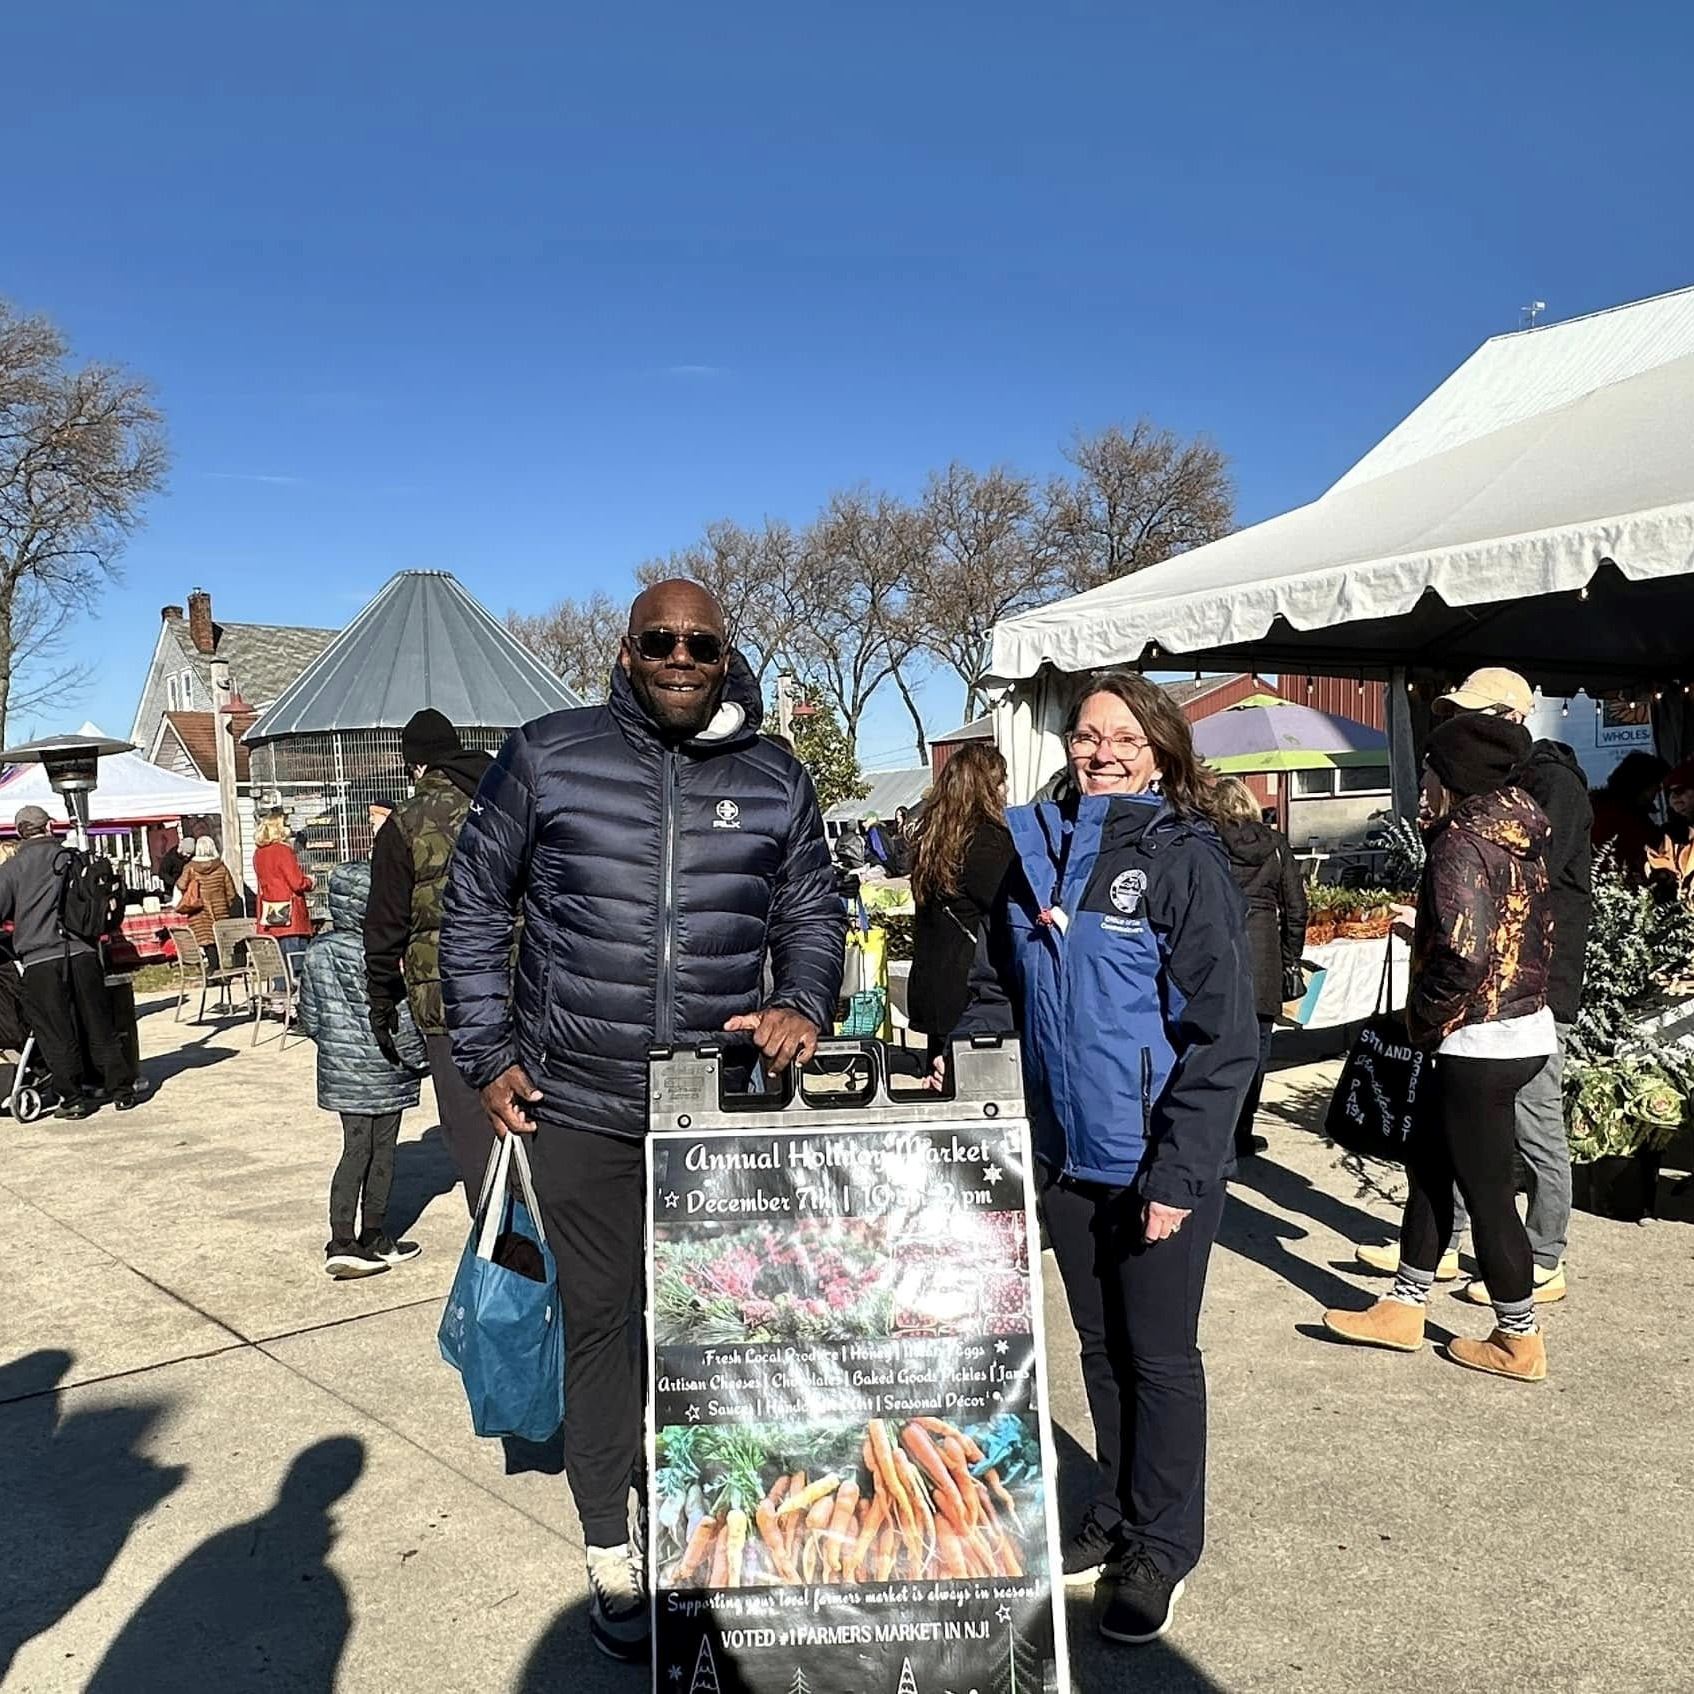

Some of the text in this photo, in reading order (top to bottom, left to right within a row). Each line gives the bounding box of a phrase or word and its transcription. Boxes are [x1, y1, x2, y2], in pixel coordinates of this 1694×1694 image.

[1602, 729, 1650, 742] WHOLES
[1384, 1043, 1413, 1062] AND
[685, 1142, 781, 1172] Annual
[686, 1188, 791, 1214] December
[796, 1185, 832, 1211] 7th
[960, 1188, 993, 1209] pm
[704, 1349, 741, 1366] Fresh
[745, 1347, 781, 1364] Local
[956, 1344, 985, 1360] Eggs
[657, 1376, 707, 1393] Artisan
[709, 1373, 763, 1391] Cheeses
[852, 1368, 895, 1387] Baked
[897, 1366, 938, 1385] Goods
[884, 1392, 943, 1411] Seasonal
[945, 1391, 986, 1408] Décor
[667, 1591, 743, 1617] Supporting
[779, 1586, 810, 1607] local
[813, 1586, 863, 1613] farmers
[865, 1584, 909, 1604] market
[912, 1584, 925, 1602] is
[927, 1582, 972, 1608] always
[974, 1583, 990, 1600] in
[721, 1619, 990, 1650] VOTED #1 FARMERS MARKET IN NJ!
